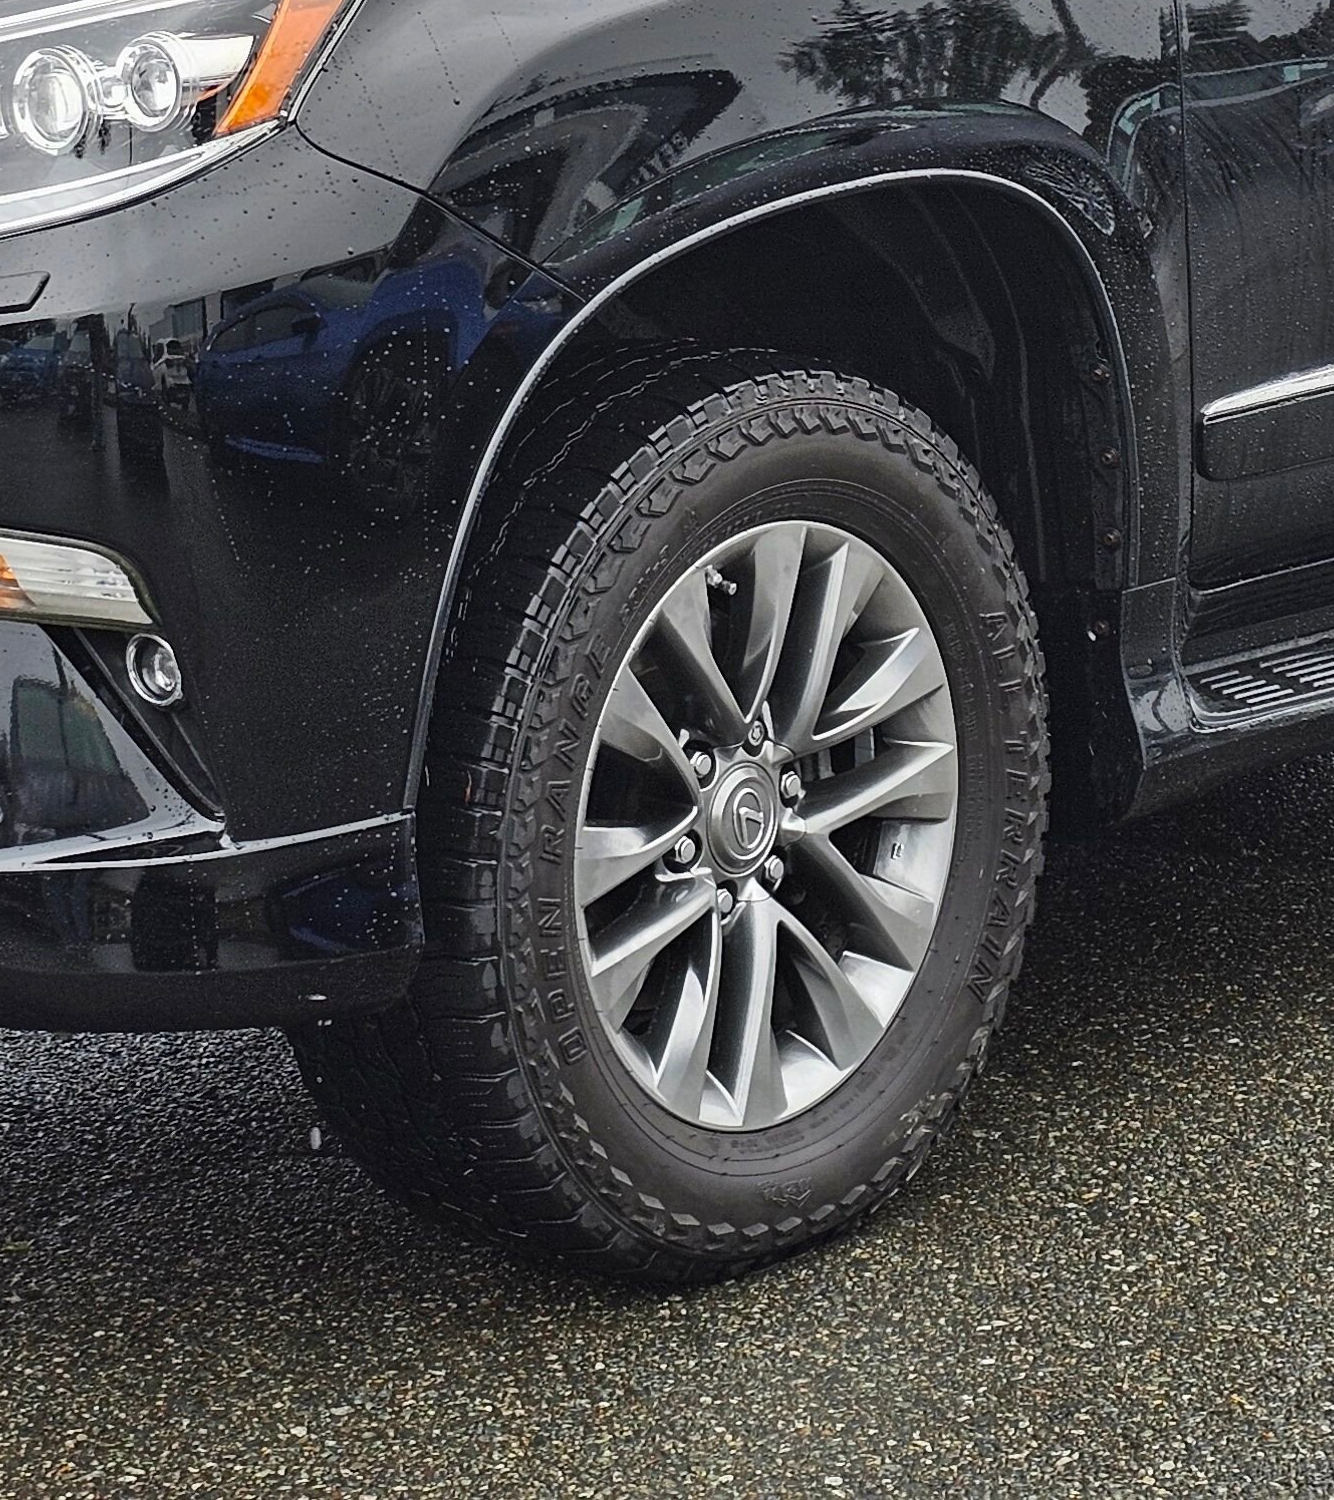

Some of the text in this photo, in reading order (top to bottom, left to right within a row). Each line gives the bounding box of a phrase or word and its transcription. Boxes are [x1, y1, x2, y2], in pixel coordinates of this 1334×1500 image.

[537, 632, 612, 1065] OPEN RANGE
[967, 730, 1028, 1005] TERRAIN
